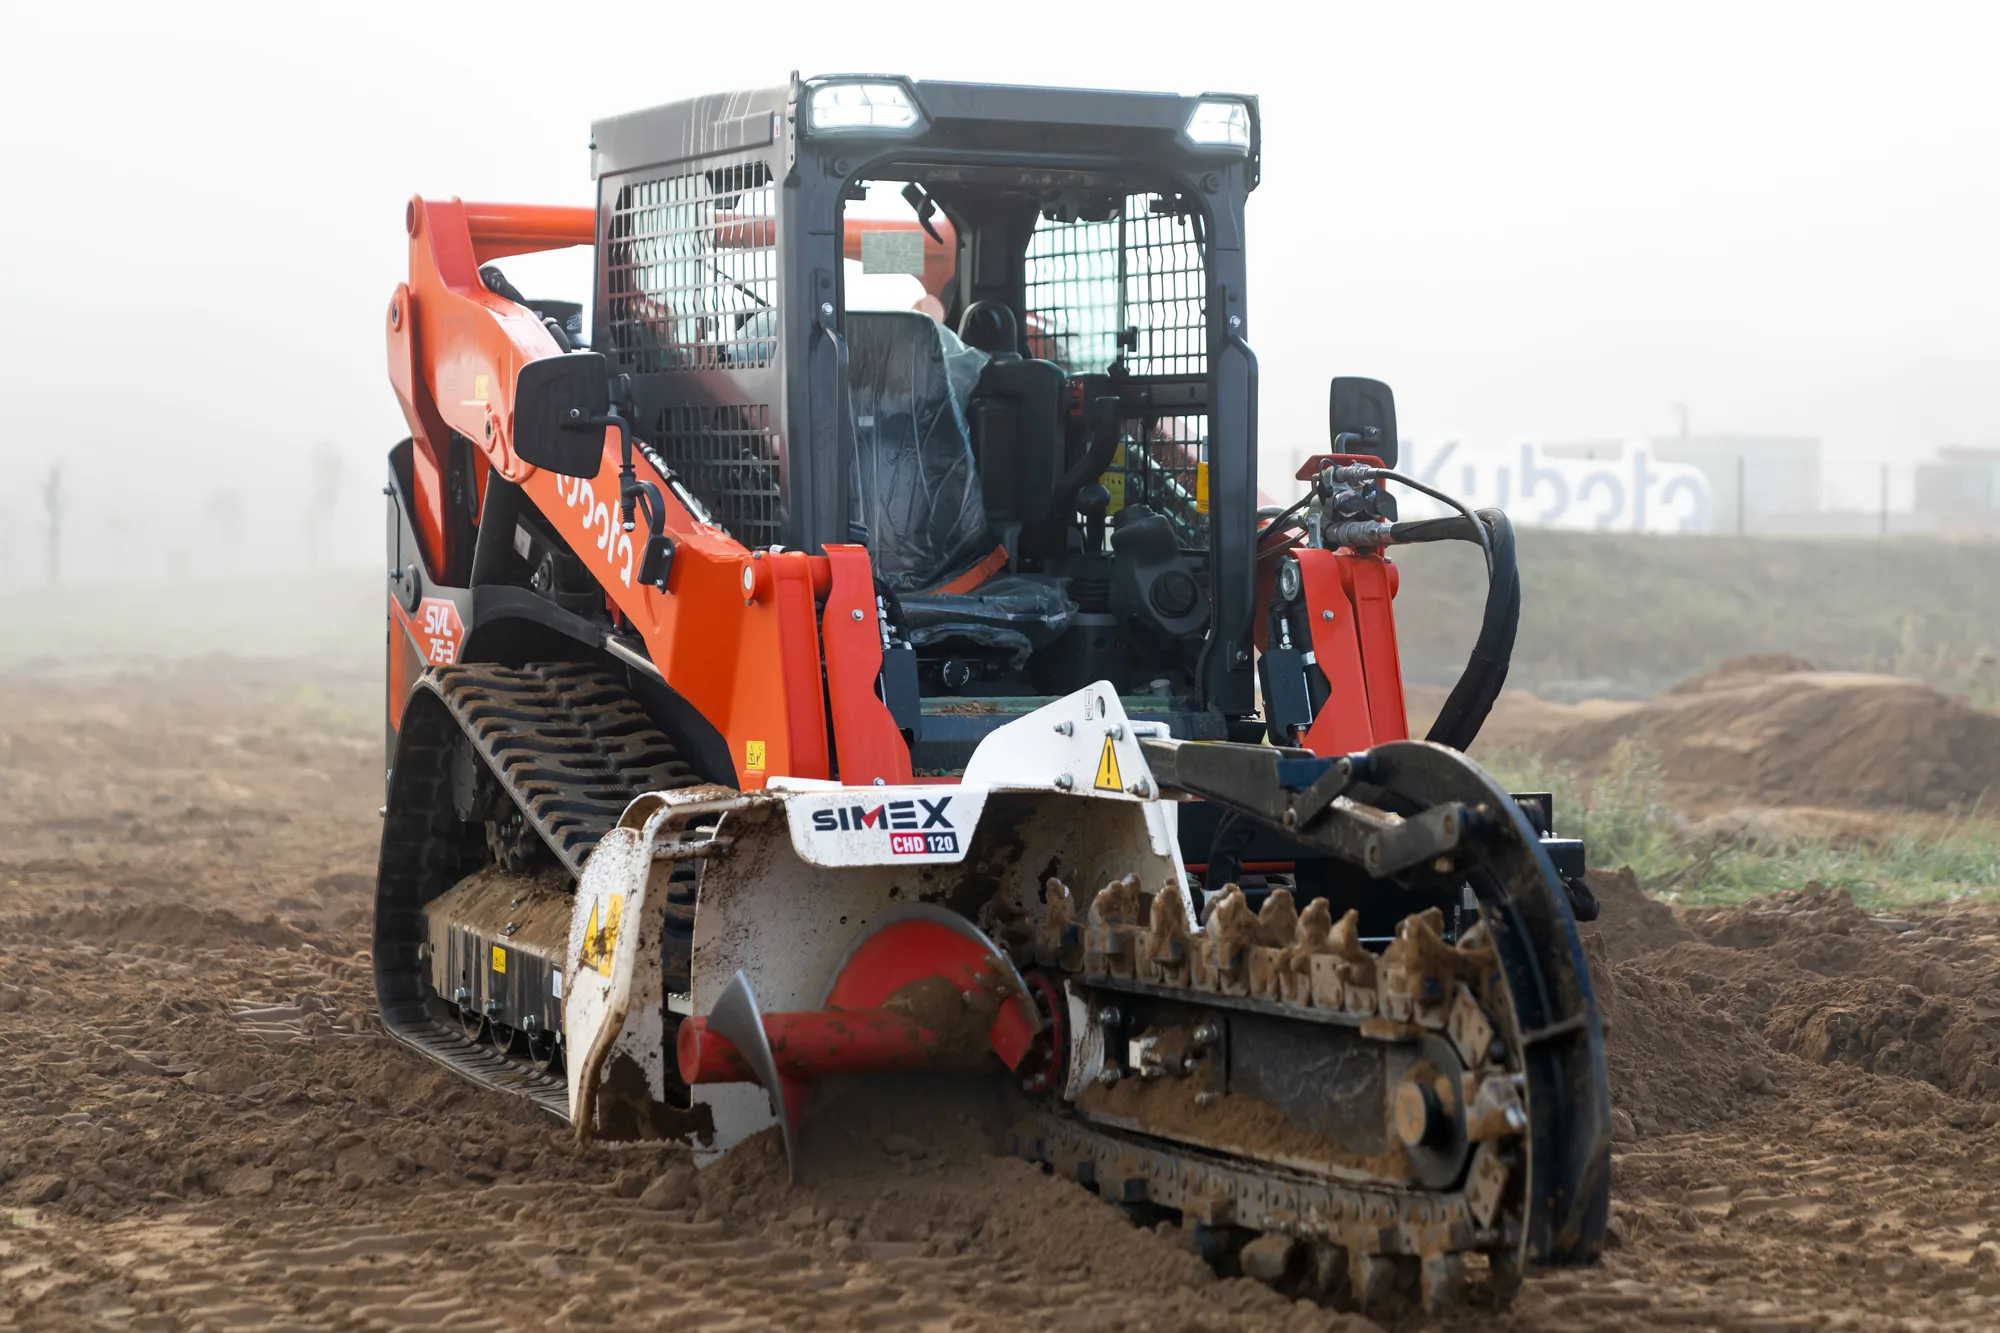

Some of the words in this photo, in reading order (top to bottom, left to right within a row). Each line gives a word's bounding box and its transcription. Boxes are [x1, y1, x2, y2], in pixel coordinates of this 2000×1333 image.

[1399, 440, 1710, 532] Kubota
[424, 605, 453, 637] SVL
[429, 637, 455, 665] 75-3
[811, 796, 955, 832] SIMEX
[892, 836, 925, 853] CHD
[926, 835, 954, 852] 120
